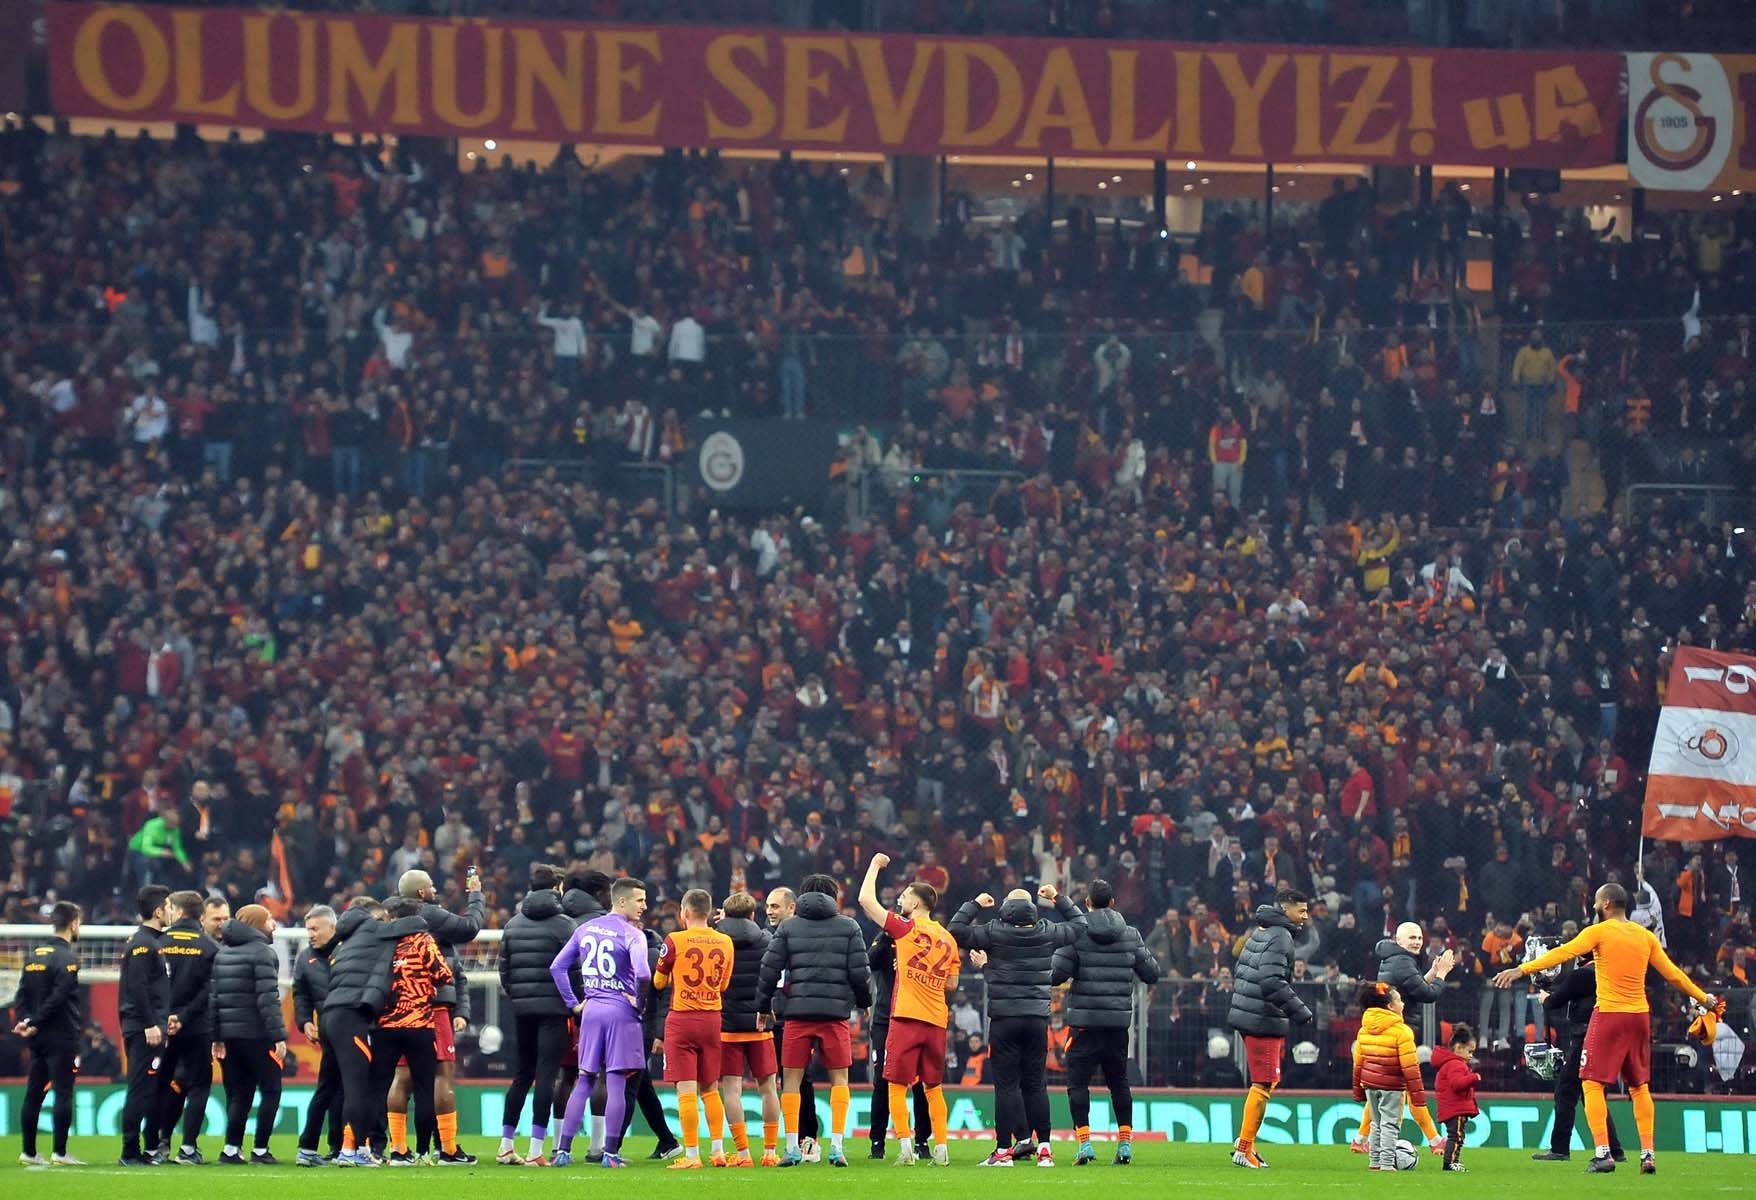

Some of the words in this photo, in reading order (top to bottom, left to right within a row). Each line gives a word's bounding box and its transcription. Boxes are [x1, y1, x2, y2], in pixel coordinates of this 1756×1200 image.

[1660, 115, 1688, 129] 1905
[580, 935, 616, 979] 26
[682, 947, 725, 988] 33
[907, 933, 951, 978] 22
